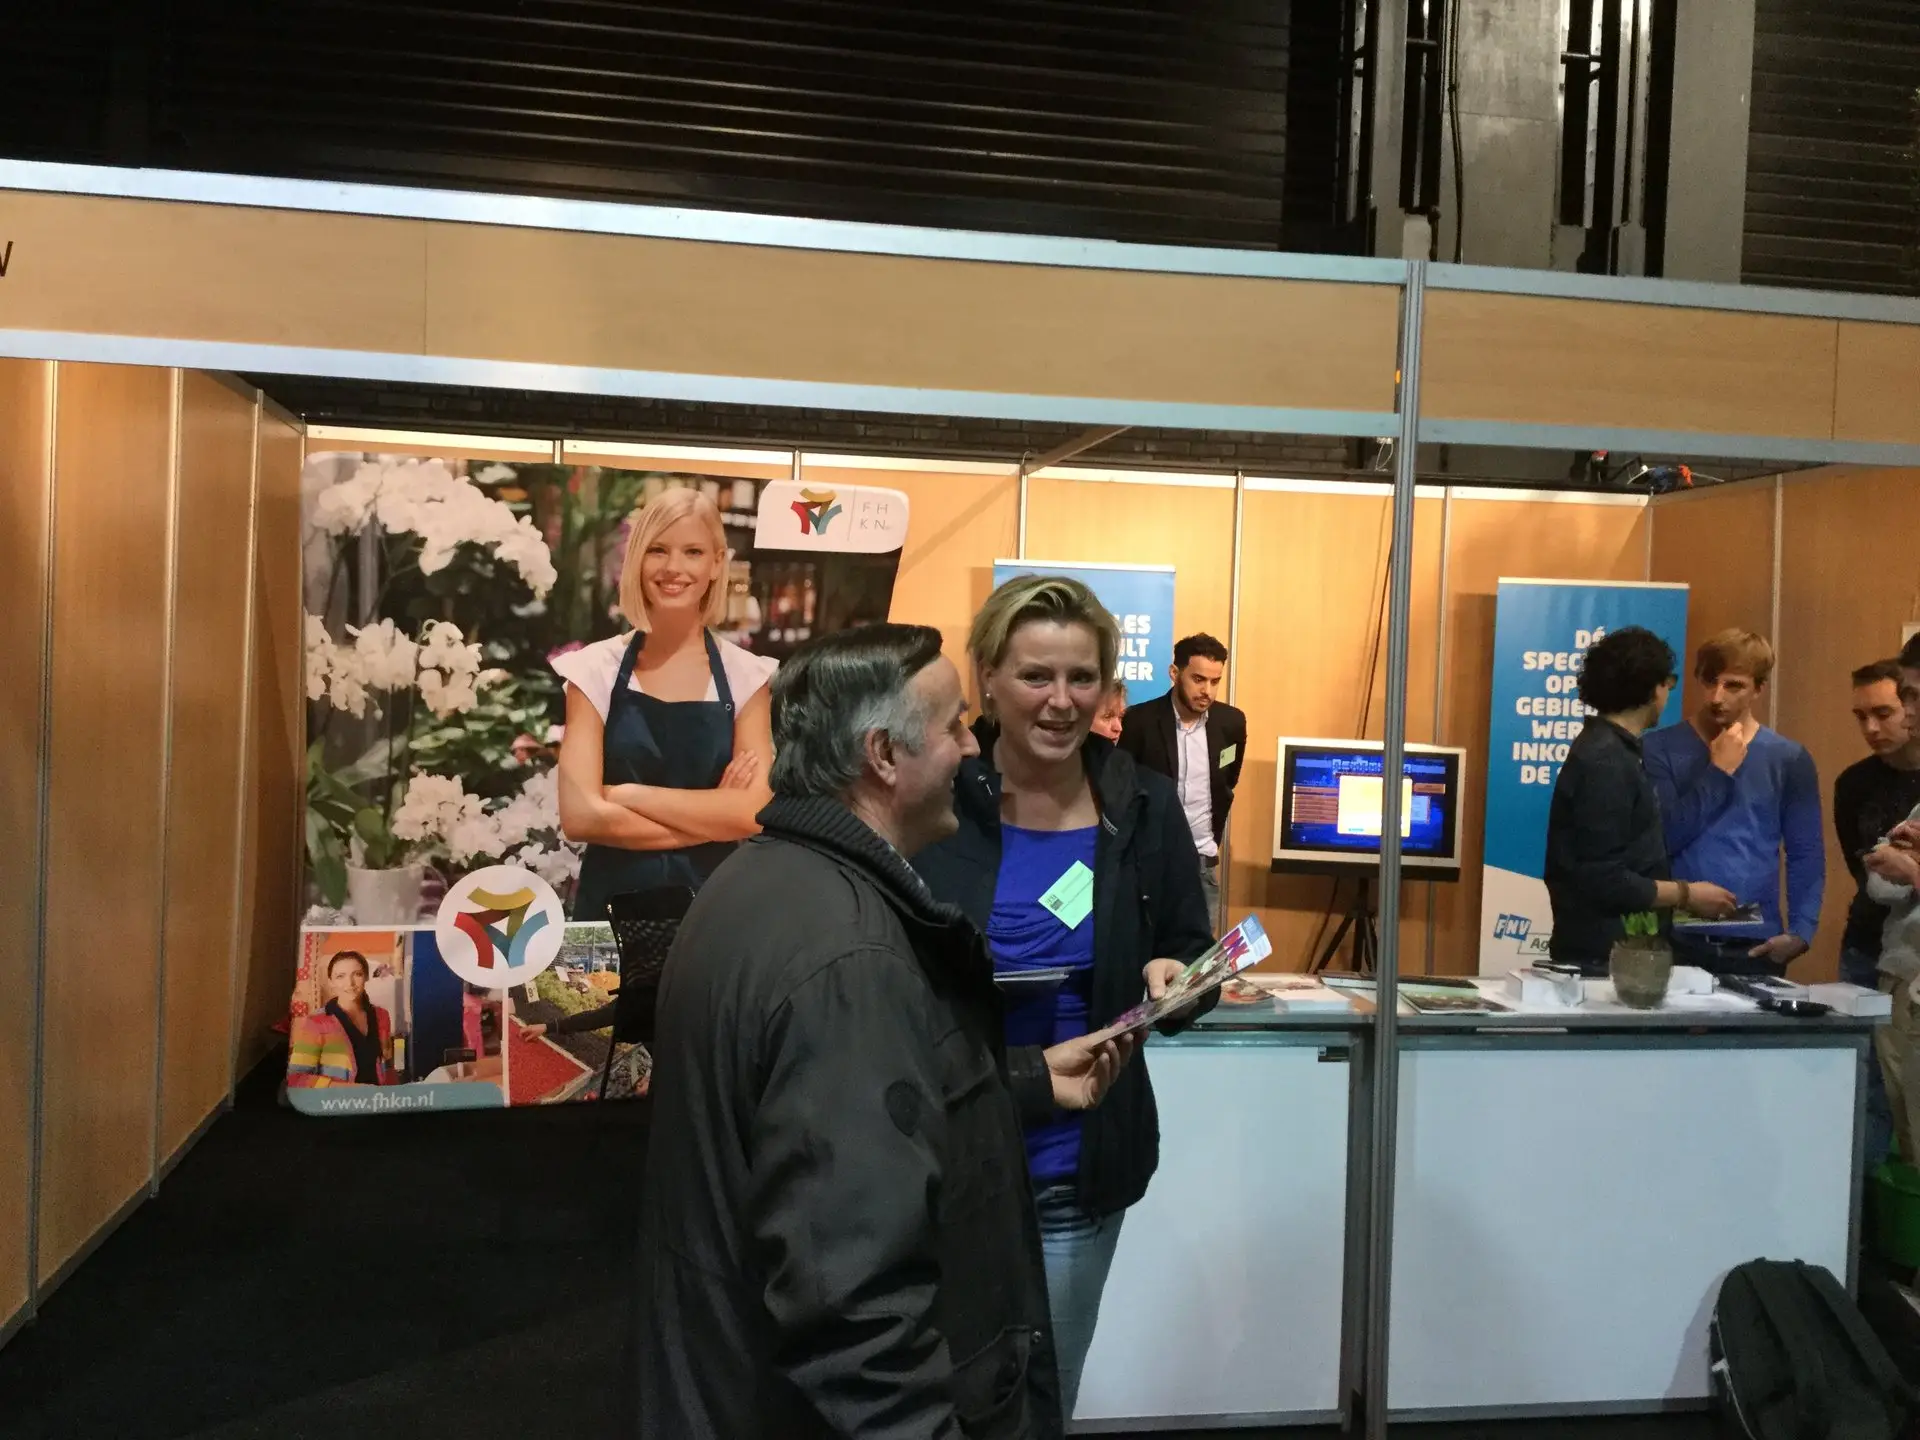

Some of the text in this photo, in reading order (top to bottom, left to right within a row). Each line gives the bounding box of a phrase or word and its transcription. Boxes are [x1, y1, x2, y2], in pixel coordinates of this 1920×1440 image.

[1522, 651, 1583, 671] SPEC
[1545, 674, 1578, 694] OP
[1531, 720, 1584, 740] WER
[1512, 742, 1571, 762] INKO
[1520, 765, 1551, 785] DE
[1494, 917, 1531, 936] FNV
[1530, 937, 1551, 952] Ag
[320, 1090, 435, 1113] www.fhkn.nl
